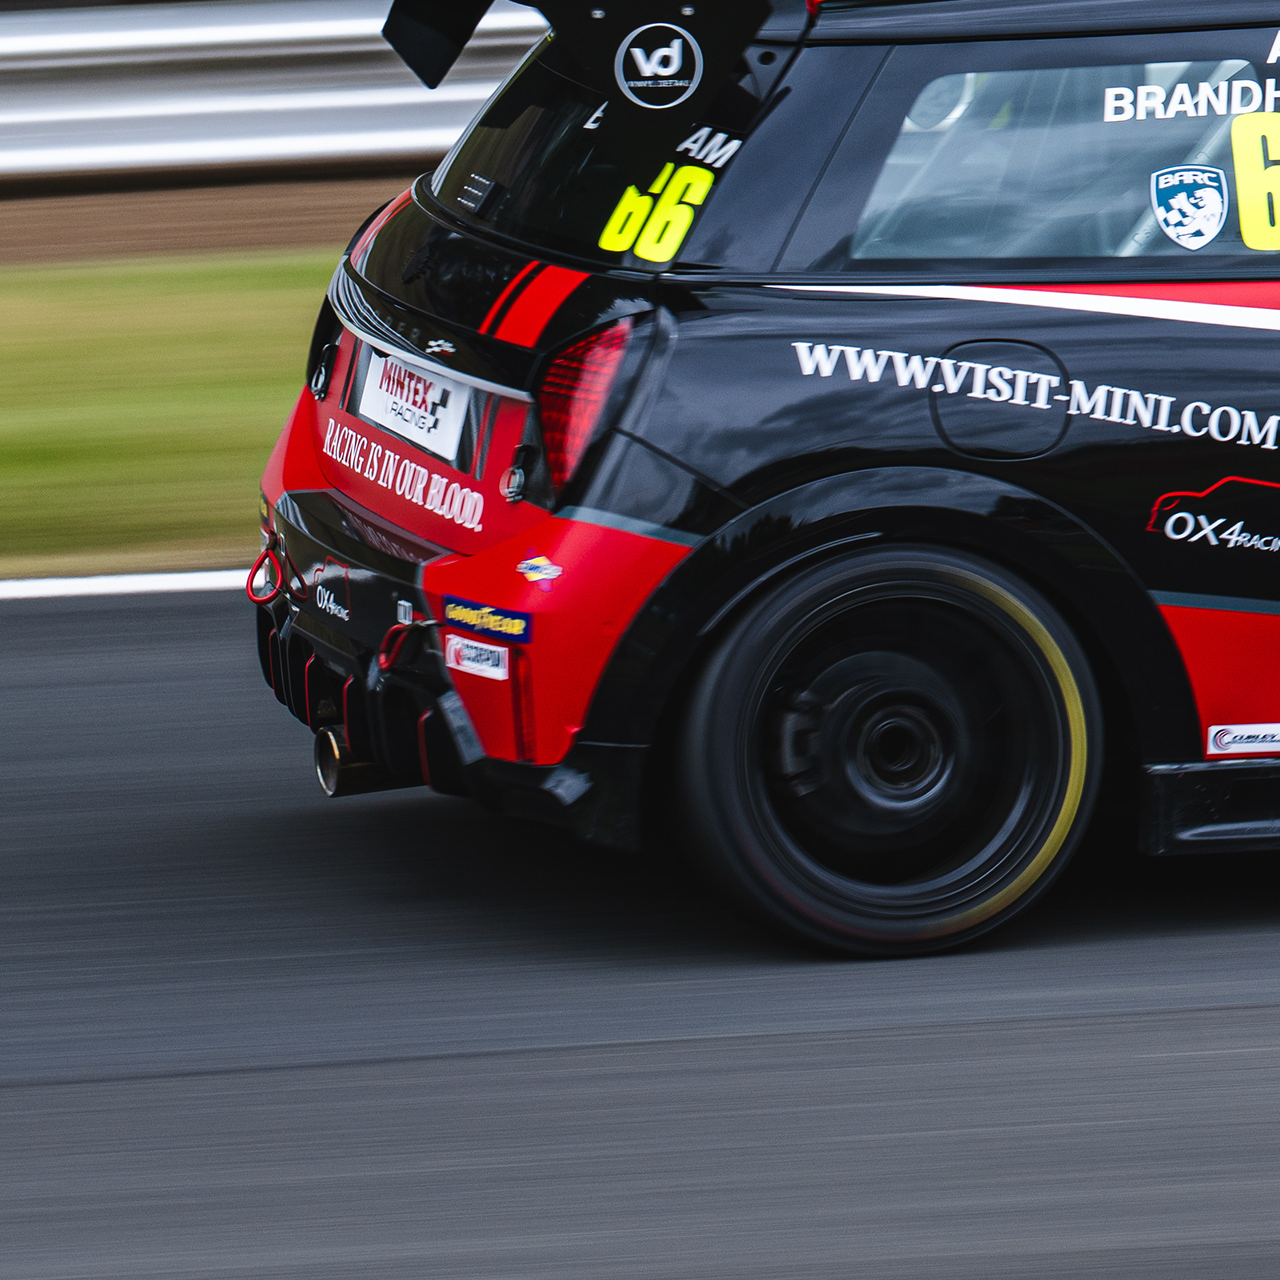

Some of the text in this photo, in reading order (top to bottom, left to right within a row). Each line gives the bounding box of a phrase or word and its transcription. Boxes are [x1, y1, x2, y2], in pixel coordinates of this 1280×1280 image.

[1158, 171, 1219, 189] BARC
[379, 358, 434, 413] MINTEX
[390, 401, 428, 430] RACING
[322, 417, 484, 533] RACING IS IN OUR BLOOD.
